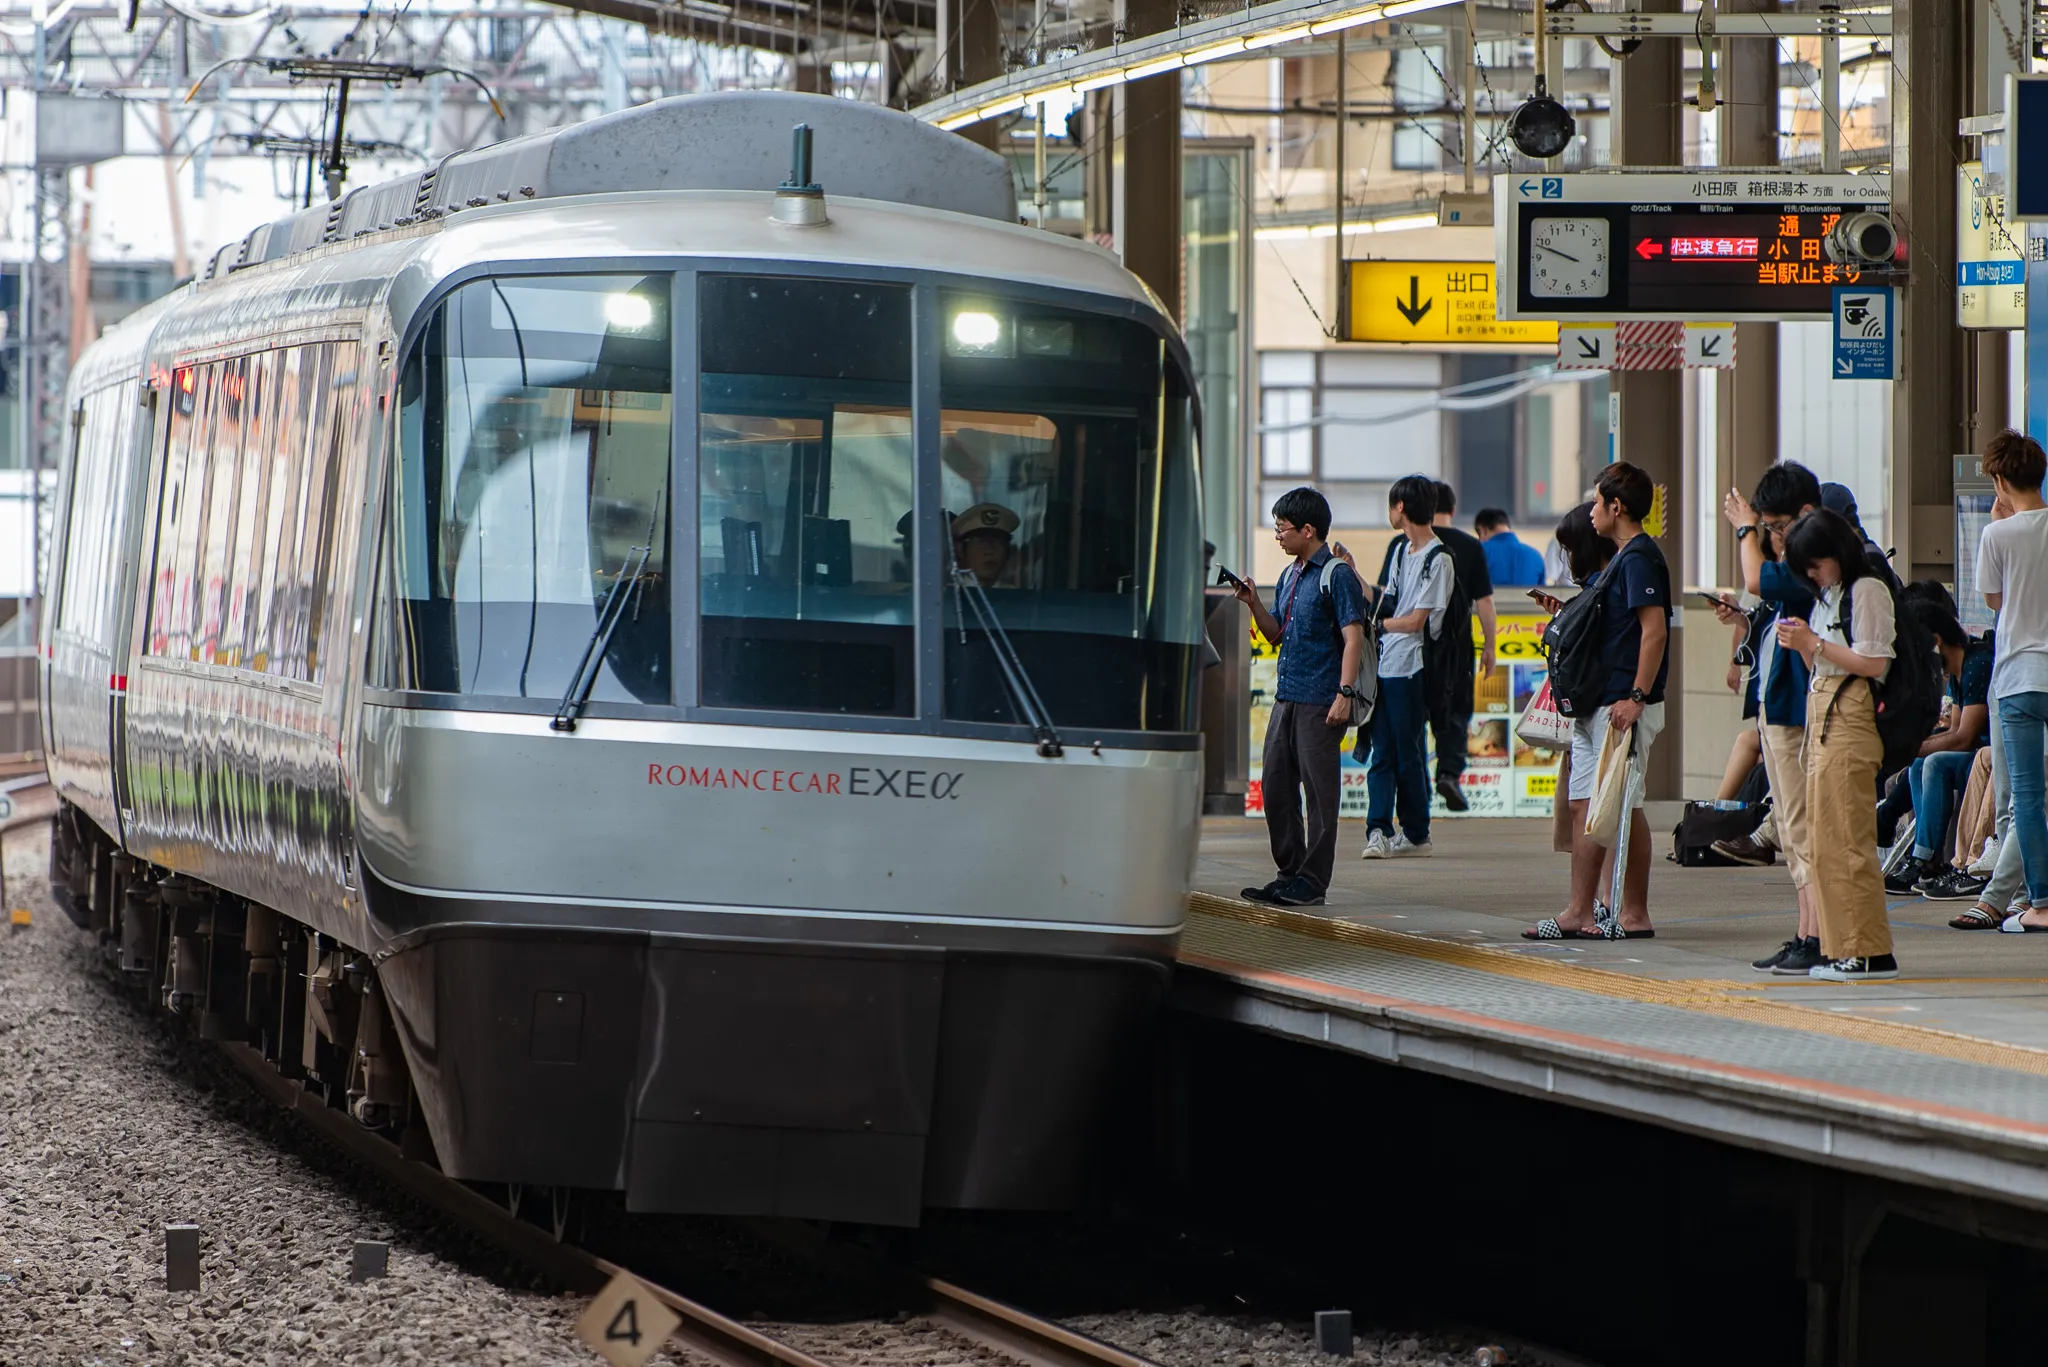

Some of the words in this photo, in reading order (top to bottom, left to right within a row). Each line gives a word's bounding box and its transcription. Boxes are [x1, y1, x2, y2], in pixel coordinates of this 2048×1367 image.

[1545, 179, 1559, 198] 2
[1692, 181, 1738, 197] 小田原
[1748, 181, 1809, 197] 箱根湯本
[1813, 186, 1834, 197] 方面
[1843, 187, 1857, 197] for
[1551, 227, 1560, 236] 11
[1564, 223, 1576, 232] 12
[1580, 228, 1586, 236] 1
[1540, 238, 1551, 246] 10
[1592, 238, 1598, 247] 2
[1671, 238, 1757, 256] 快速急行
[1768, 238, 1820, 260] 小田
[1536, 253, 1542, 262] 9
[1596, 253, 1602, 262] 3
[1540, 269, 1547, 277] 8
[1591, 269, 1598, 277] 4
[1758, 262, 1861, 285] 当駅止まり
[1447, 272, 1488, 293] 出口
[1552, 279, 1558, 288] 7
[1565, 283, 1572, 291] 6
[1580, 279, 1587, 288] 5
[1456, 300, 1475, 310] Exit
[1479, 300, 1496, 311] (Ea
[1527, 714, 1570, 730] RADEON
[648, 763, 842, 795] ROMANCECAR
[1343, 774, 1367, 787] スク
[605, 1299, 642, 1347] 4
